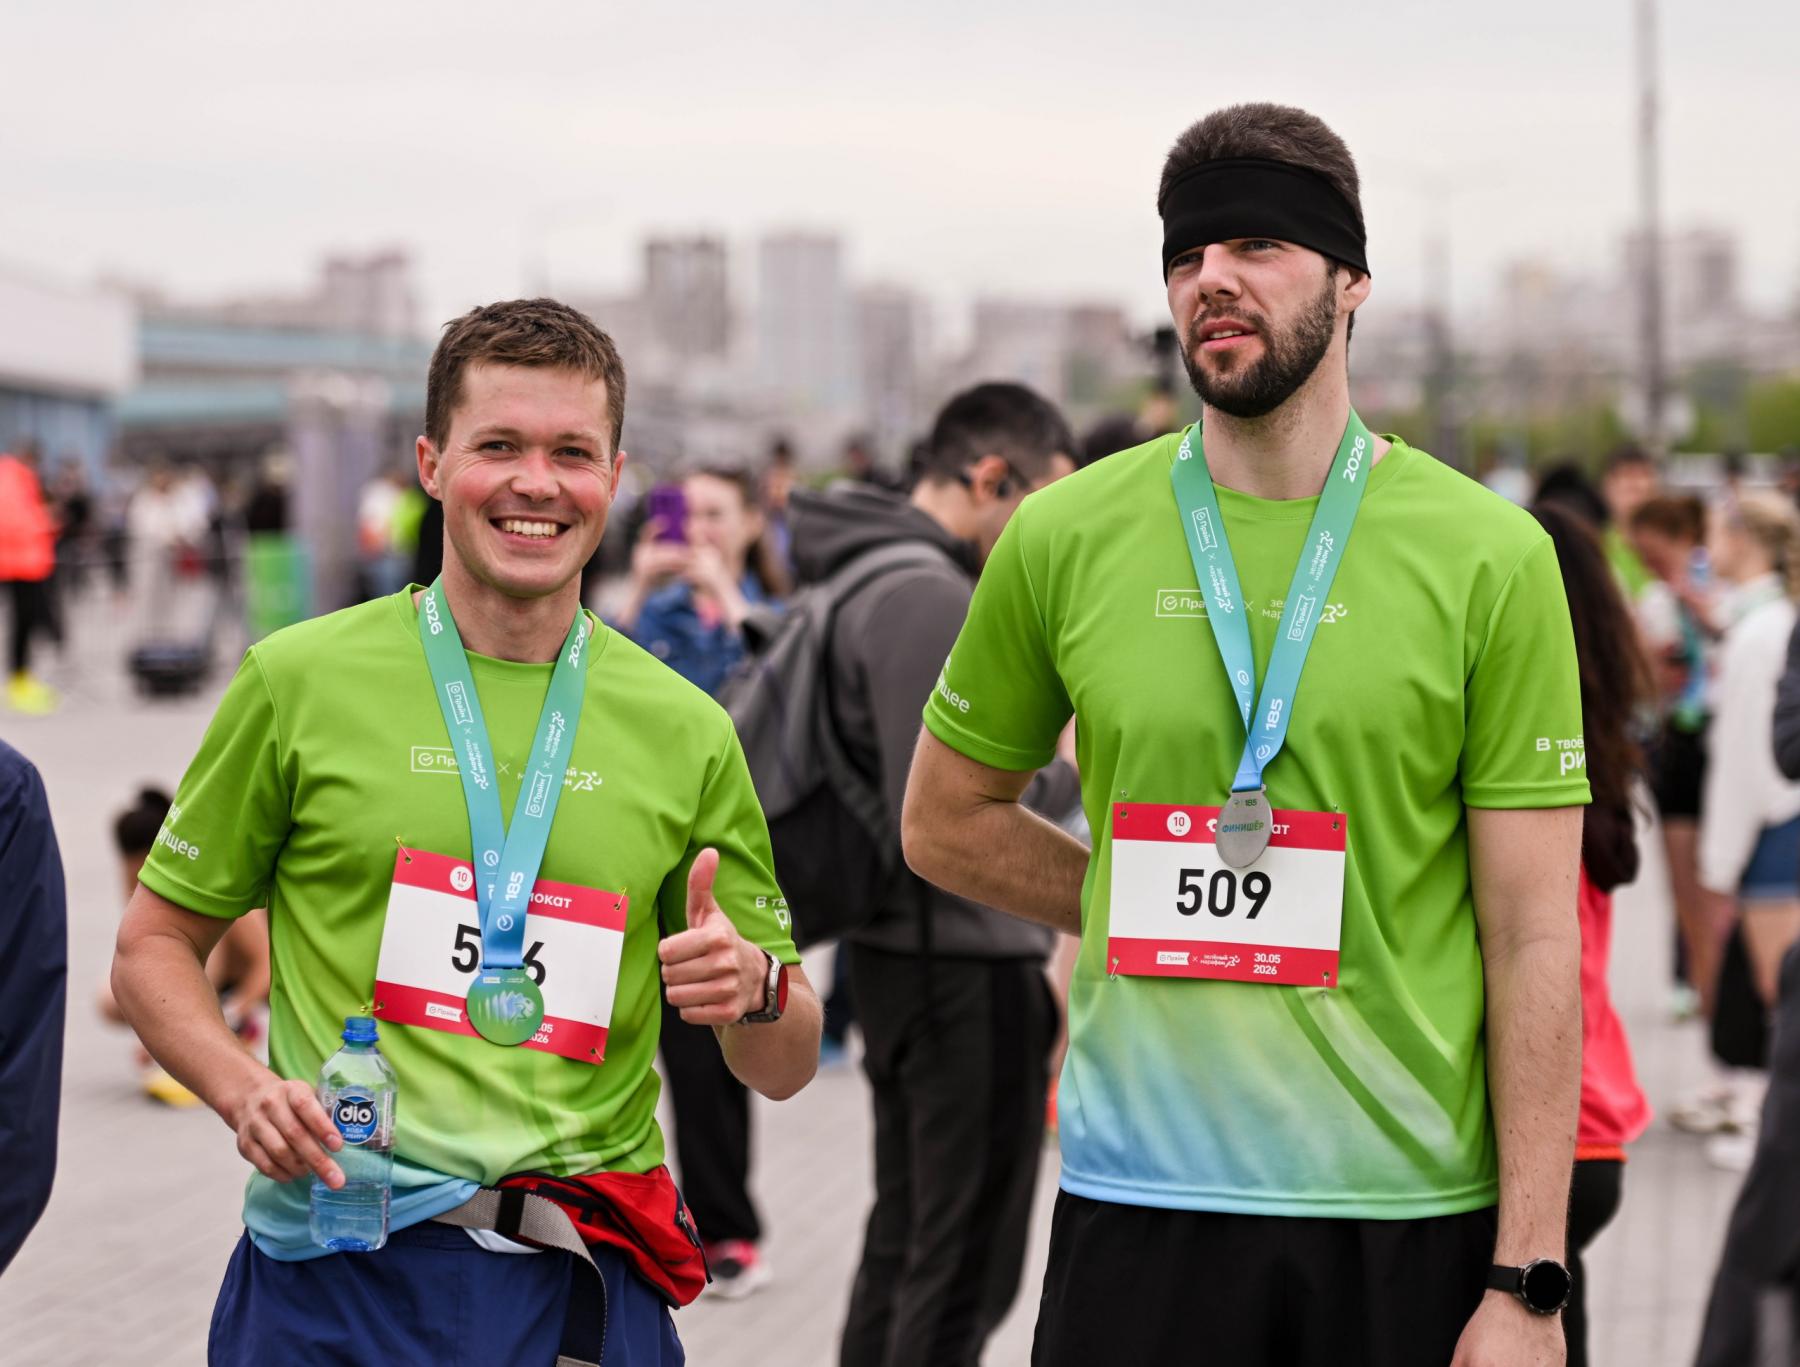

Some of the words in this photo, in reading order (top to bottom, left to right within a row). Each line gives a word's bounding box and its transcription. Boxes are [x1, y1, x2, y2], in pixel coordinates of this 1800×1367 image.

[1179, 434, 1192, 460] 26
[1343, 435, 1366, 483] 2026
[1180, 597, 1207, 610] Пра
[425, 592, 443, 635] 2026
[568, 624, 586, 669] 2026
[1265, 698, 1283, 731] 185
[1536, 737, 1551, 751] В
[1556, 735, 1584, 749] твоё
[1560, 751, 1586, 776] ри
[1173, 816, 1185, 827] 10
[1222, 821, 1264, 833] ФИНИШЁР
[457, 871, 468, 882] 10
[505, 871, 524, 902] 185
[1176, 868, 1272, 919] 509
[530, 892, 572, 908] окат
[452, 924, 546, 988] 56
[1253, 952, 1281, 964] 30.05
[1253, 964, 1278, 975] 2026
[536, 1022, 553, 1033] .05
[529, 1032, 549, 1044] 026
[340, 1105, 372, 1122] dio
